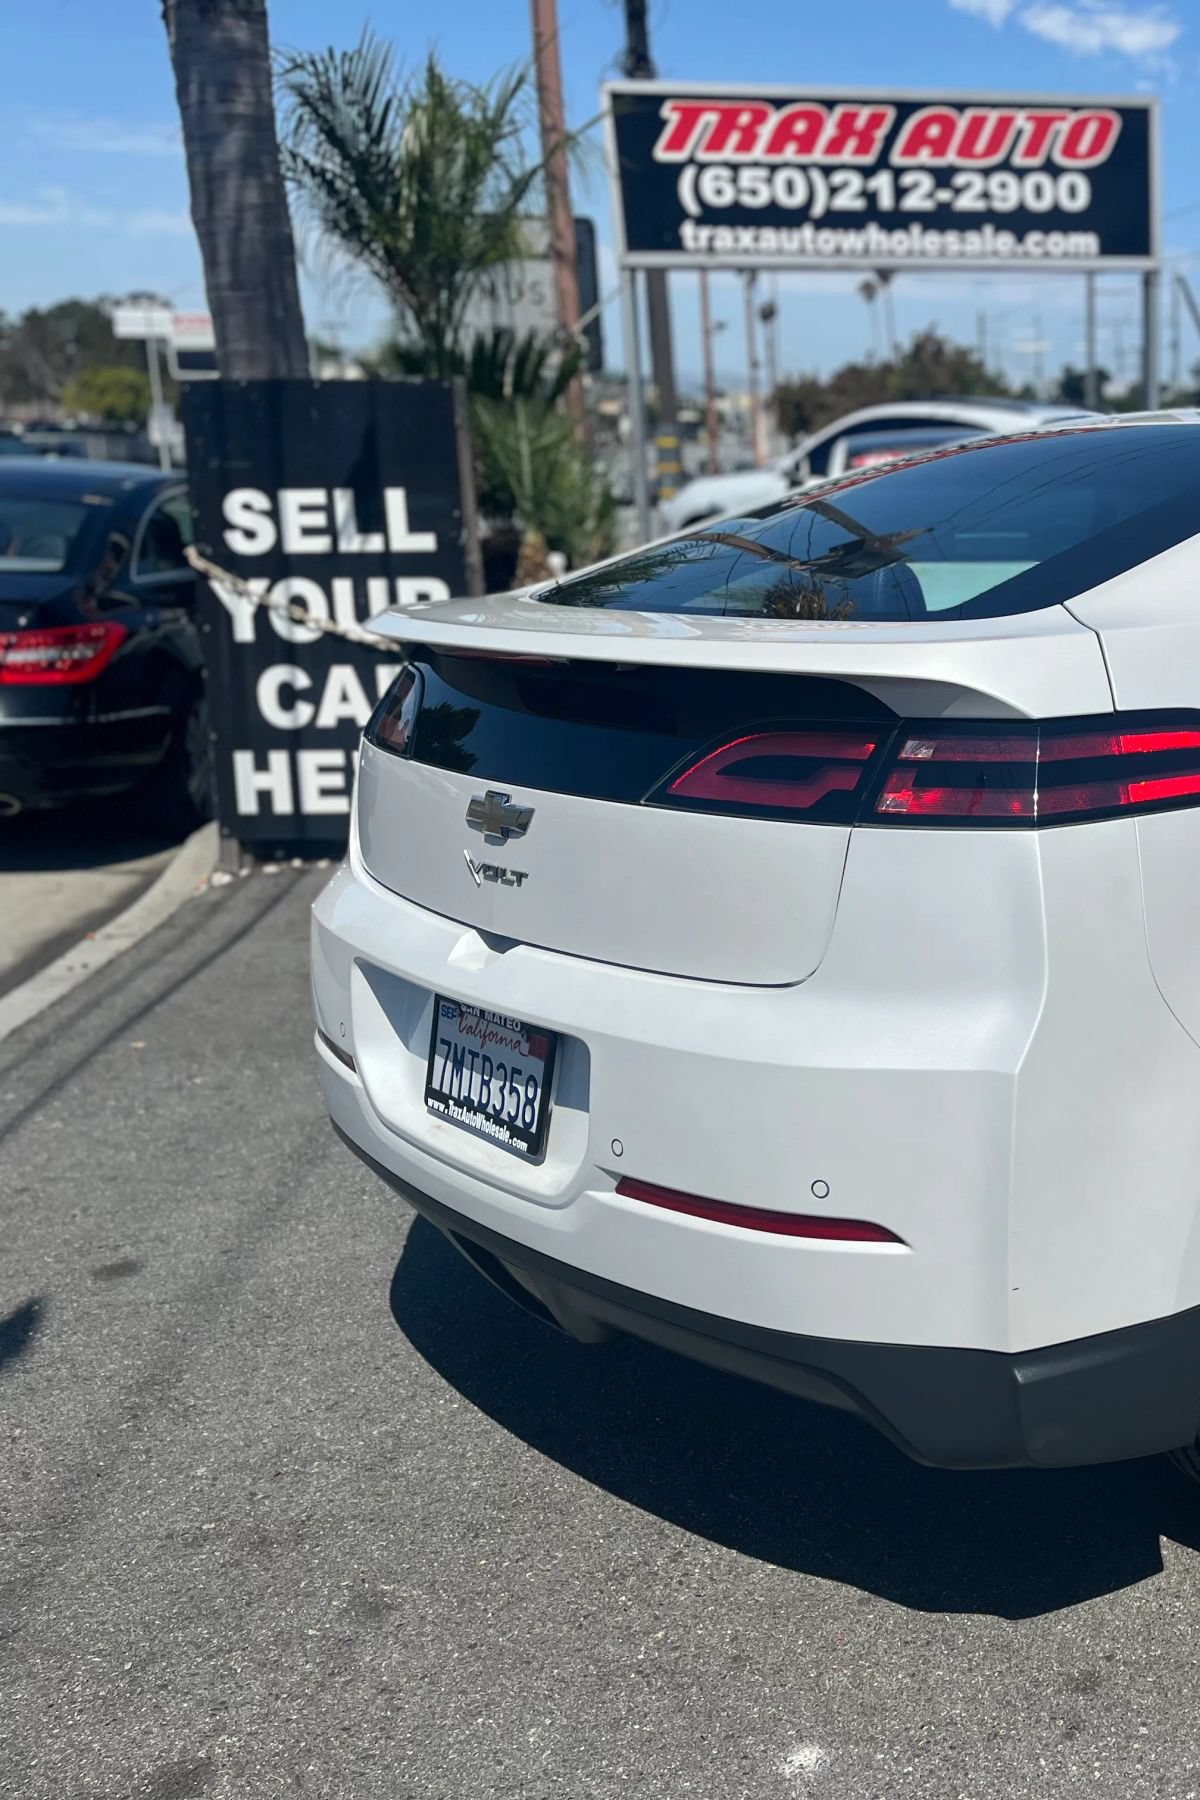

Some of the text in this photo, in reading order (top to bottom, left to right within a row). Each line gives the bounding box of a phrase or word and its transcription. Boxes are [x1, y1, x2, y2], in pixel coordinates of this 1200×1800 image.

[653, 99, 1122, 168] TRAX AUTO
[677, 165, 1092, 218] (650)212-2900
[680, 220, 1100, 257] traxautowholesale.com
[222, 486, 437, 556] SELL
[256, 663, 405, 730] CA
[232, 749, 360, 816] HE
[463, 849, 530, 888] VOLT
[458, 1011, 529, 1058] California
[460, 1002, 521, 1031] SAN MATEO
[439, 1037, 539, 1131] 7MIB358
[427, 1097, 528, 1152] www.TraxAutoWholesale.com
